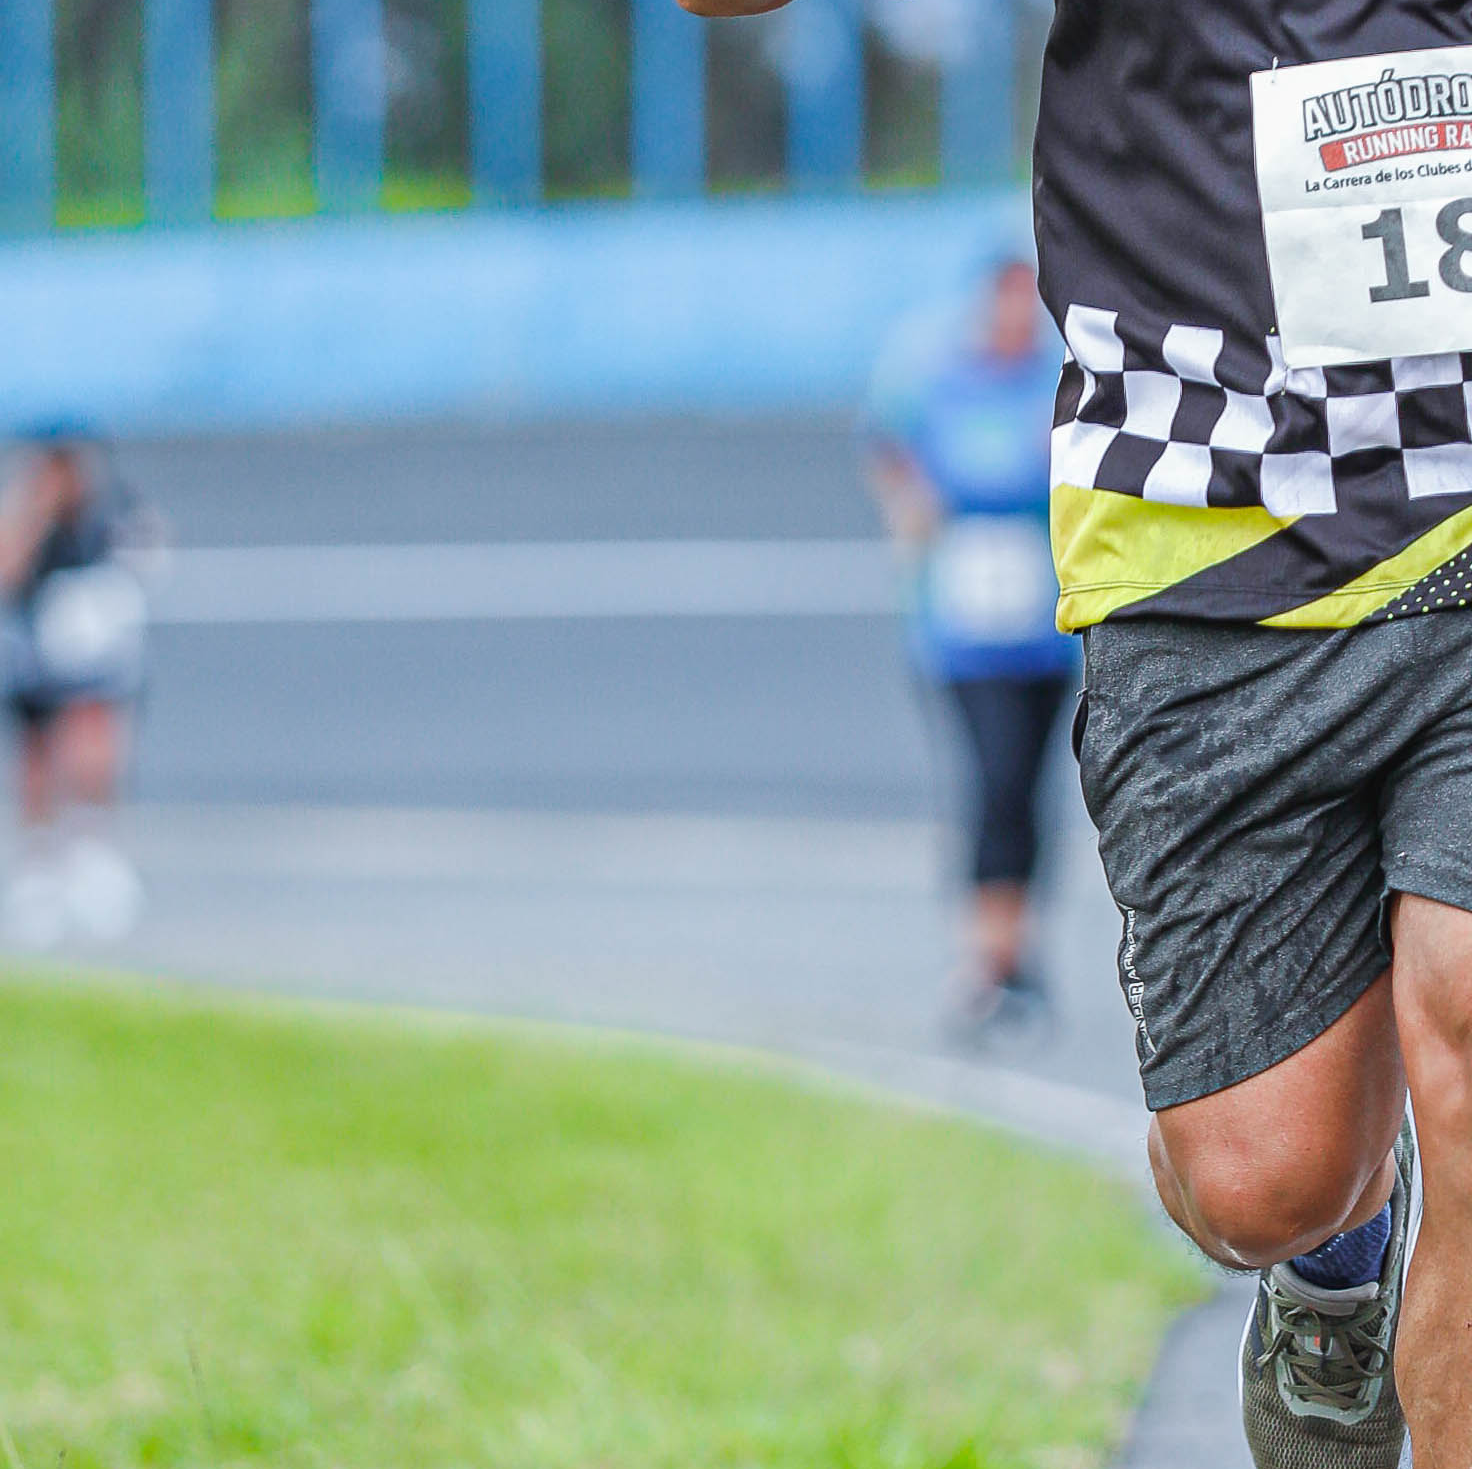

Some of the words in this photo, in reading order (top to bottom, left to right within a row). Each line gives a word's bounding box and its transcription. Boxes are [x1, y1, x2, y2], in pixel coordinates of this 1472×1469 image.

[1342, 123, 1439, 165] RUNNING
[1304, 179, 1320, 193] La
[1323, 174, 1371, 191] Carrera
[1375, 169, 1392, 183] de
[1395, 167, 1414, 181] los
[1417, 162, 1461, 178] Clubes
[1123, 909, 1141, 980] ARMOUR
